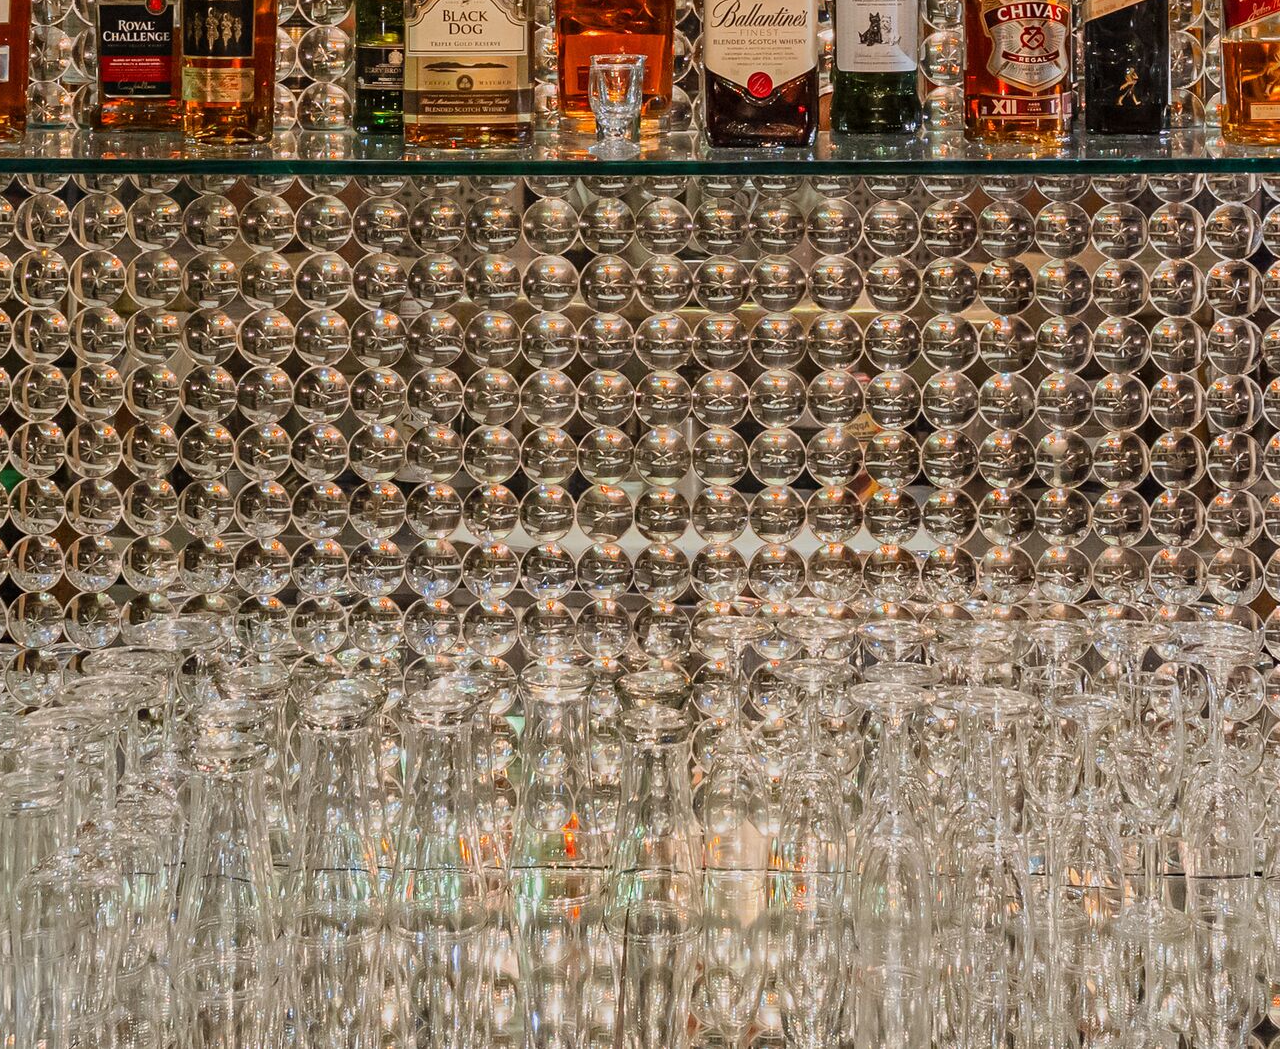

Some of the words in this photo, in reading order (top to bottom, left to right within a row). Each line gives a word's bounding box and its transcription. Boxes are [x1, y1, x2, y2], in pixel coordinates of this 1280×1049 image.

[443, 9, 488, 22] BLACK
[997, 3, 1062, 21] CHIVAS
[118, 20, 155, 32] ROYAL
[449, 22, 483, 35] DOG
[103, 31, 170, 42] CHALLENGE
[992, 99, 1017, 114] XII
